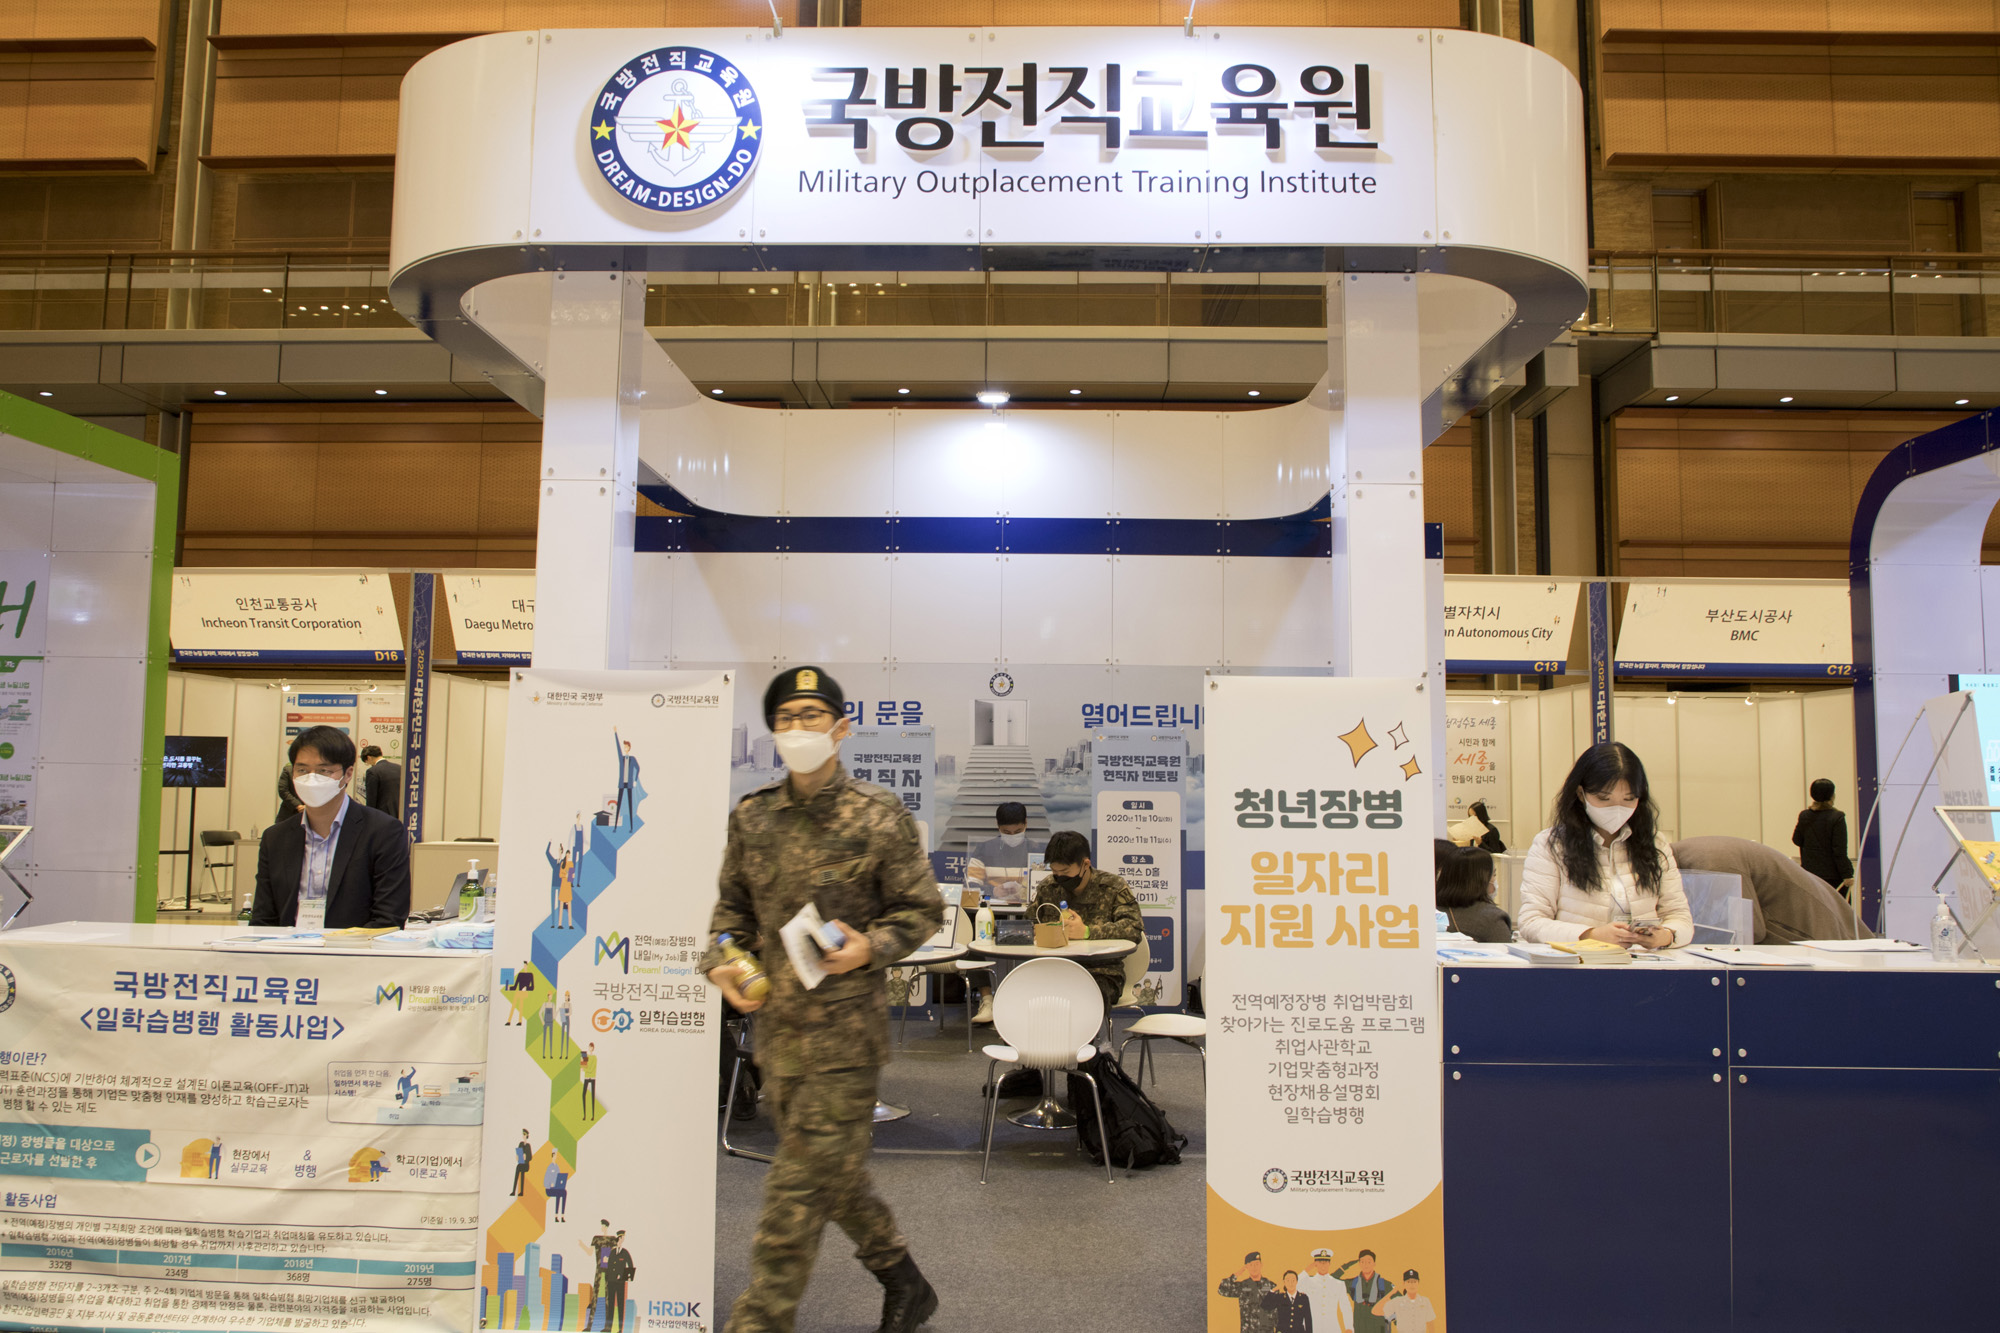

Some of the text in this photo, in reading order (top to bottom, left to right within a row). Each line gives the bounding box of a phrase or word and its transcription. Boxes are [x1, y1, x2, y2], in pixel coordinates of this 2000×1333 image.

[600, 51, 755, 111] 국방전직교육원
[804, 63, 1379, 149] 국방전직교육원
[597, 148, 752, 208] DREAM-DESIGN-DO
[799, 169, 1377, 199] Military Outplacement Training Institute
[235, 597, 317, 612] 인천교통공사
[512, 599, 535, 613] 대구
[1444, 605, 1501, 620] 별자치시
[1705, 609, 1793, 623] 부산도시공사
[201, 617, 362, 631] Incheon Transit Corporation
[464, 618, 534, 632] Daegu Metro
[1457, 626, 1554, 641] Autonomous City
[1730, 630, 1760, 641] BMC
[374, 651, 398, 661] D16
[1534, 661, 1558, 672] C13
[1826, 665, 1852, 676] C12
[547, 692, 604, 702] 대한민국 국방부
[667, 695, 719, 704] 국방전직교육원
[875, 701, 924, 725] 문을
[1081, 703, 1204, 730] 열어드립니
[1478, 716, 1497, 730] 세종
[1459, 738, 1496, 746] 시민과 함께
[853, 754, 922, 764] 국방전직교육원
[1097, 755, 1181, 767] 국방전직교육원
[408, 754, 421, 808] 일자리
[1103, 770, 1178, 782] 현직자 멘토링
[1452, 775, 1496, 784] 만들어 갑니다
[1234, 788, 1403, 829] 청년장병
[1106, 814, 1133, 823] 2020년
[1107, 836, 1134, 844] 2020년
[1117, 867, 1160, 877] 코엑스 D홀
[1251, 851, 1389, 896] 일자리
[1220, 903, 1420, 949] 지원 사업
[634, 935, 696, 947] 전역(예정)장병의
[632, 966, 661, 974] Dream!
[663, 966, 692, 976] Design!
[113, 970, 319, 1005] 국방전직교육원
[409, 985, 446, 994] 내일을 위한
[593, 982, 706, 1003] 국방전직교육원
[408, 994, 439, 1004] Dream!
[441, 994, 475, 1005] Design!
[1232, 994, 1413, 1011] 전역예정장병 취업박람회
[80, 1007, 345, 1040] <일학습병행 활동사업>
[639, 1010, 705, 1027] 일학습병행
[1220, 1016, 1425, 1034] 찾아가는 진로도움 프로그램
[1275, 1038, 1372, 1056] 취업사관학교
[0, 1051, 47, 1065] 행이란?
[1267, 1061, 1379, 1079] 기업맞춤형과정
[75, 1072, 117, 1087] 기반하여
[120, 1075, 172, 1088] 체계적으로
[176, 1077, 208, 1091] 설계된
[210, 1080, 310, 1094] 이론교육(OFF-JT)과
[333, 1079, 361, 1087] 일하면서
[16, 1085, 309, 1109] 훈련과정을 통해 기업은 맞춤형 인재를 양성하고 학습근로자는
[1268, 1083, 1380, 1101] 현장채용설명회
[3, 1099, 97, 1113] 병행 할 수 있는 제도
[1284, 1106, 1364, 1125] 일학습병행
[0, 1134, 115, 1151] 정) 장병들을 대상으로
[0, 1151, 97, 1169] 근로자를 선발한 후
[233, 1149, 270, 1161] 현장에서
[303, 1149, 311, 1161] &
[396, 1155, 463, 1168] 학교(기업)에서
[231, 1162, 268, 1174] 실무교육
[294, 1164, 317, 1178] 병행
[409, 1168, 448, 1180] 이론교육
[1290, 1170, 1385, 1185] 국방전직교육원
[5, 1192, 57, 1209] 활동사업
[11, 1217, 391, 1243] 전역(예정)장병의 개인별 구직희망 조건에 따라 일학습병행 학습기업과 취업매칭을 유도하고 있습니다.
[46, 1248, 435, 1274] 2016년 2017년 2018년 2019년
[48, 1260, 432, 1287] 332명 234명 368명 275명
[648, 1300, 701, 1318] HRDK
[648, 1319, 700, 1330] 한국산업인력공단
